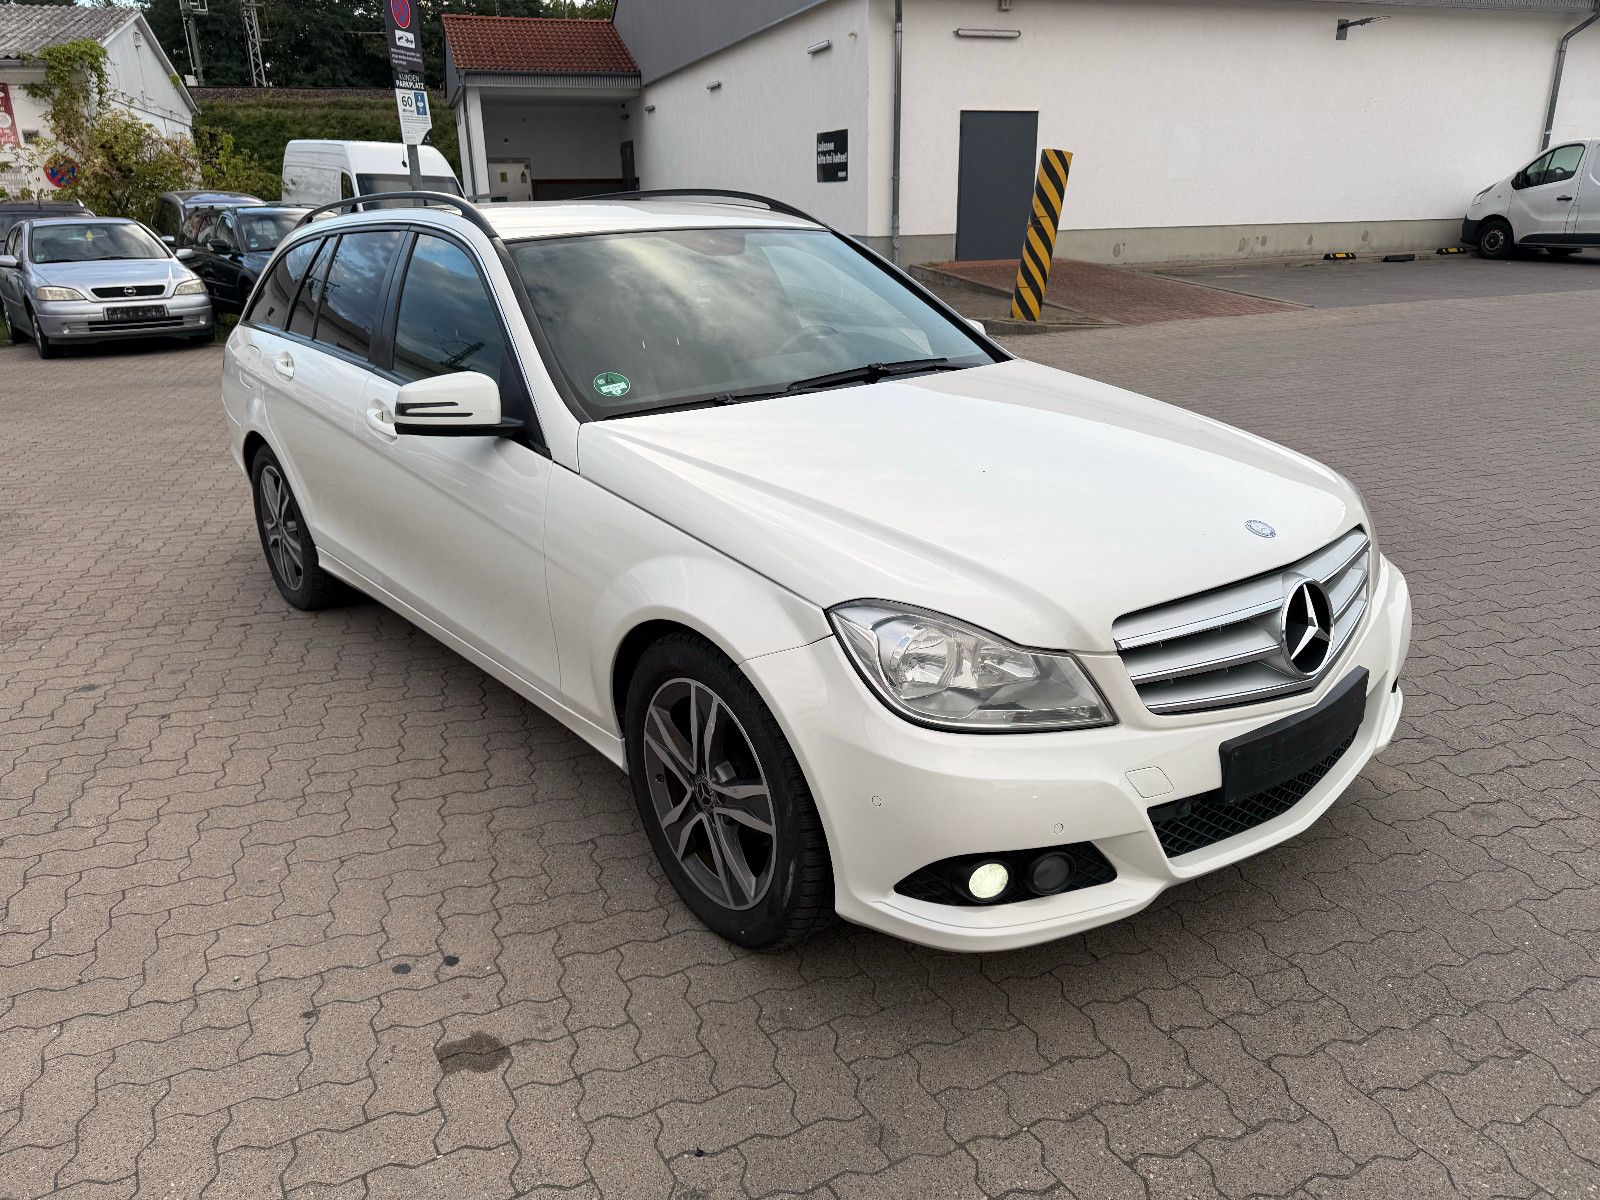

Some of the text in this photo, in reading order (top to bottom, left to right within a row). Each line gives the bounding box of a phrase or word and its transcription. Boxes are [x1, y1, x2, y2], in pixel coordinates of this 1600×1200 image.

[398, 73, 420, 82] KUNDEN
[395, 80, 424, 89] PARKPLATZ
[401, 95, 413, 107] 60
